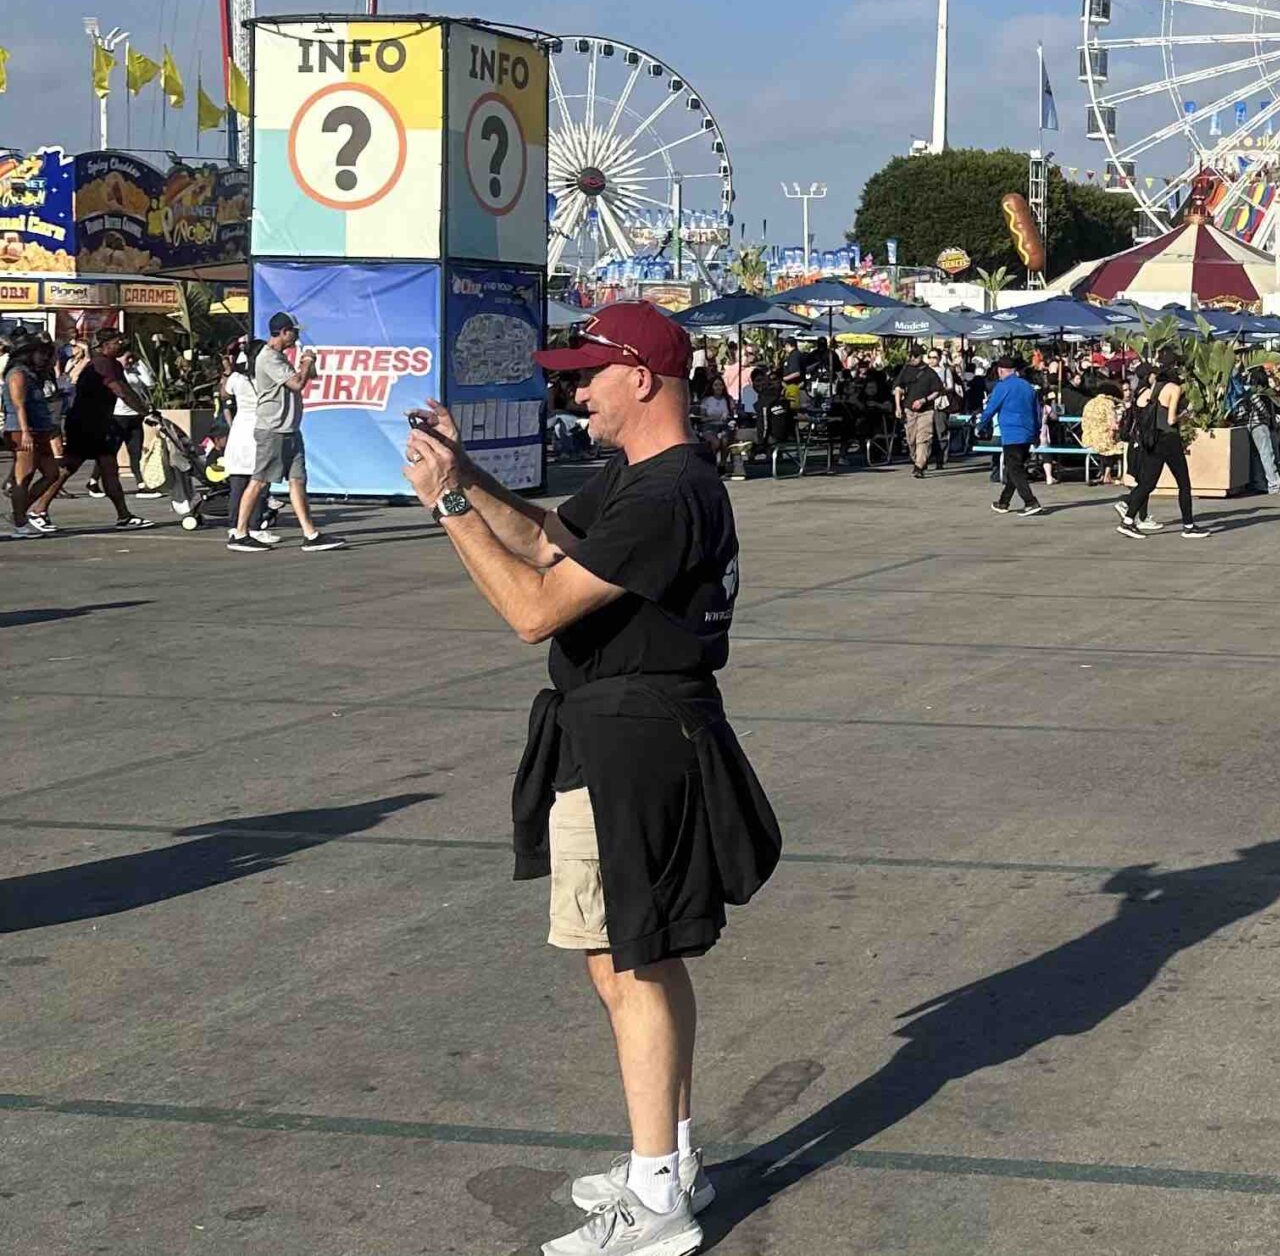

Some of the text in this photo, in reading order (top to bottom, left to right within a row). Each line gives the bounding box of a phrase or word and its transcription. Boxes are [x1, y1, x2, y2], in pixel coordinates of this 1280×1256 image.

[298, 39, 407, 73] INFO
[469, 44, 530, 90] INFO
[124, 288, 178, 304] CARAMEL
[895, 320, 930, 331] Modelo
[283, 346, 429, 372] TTRESS
[303, 375, 390, 401] FIRM
